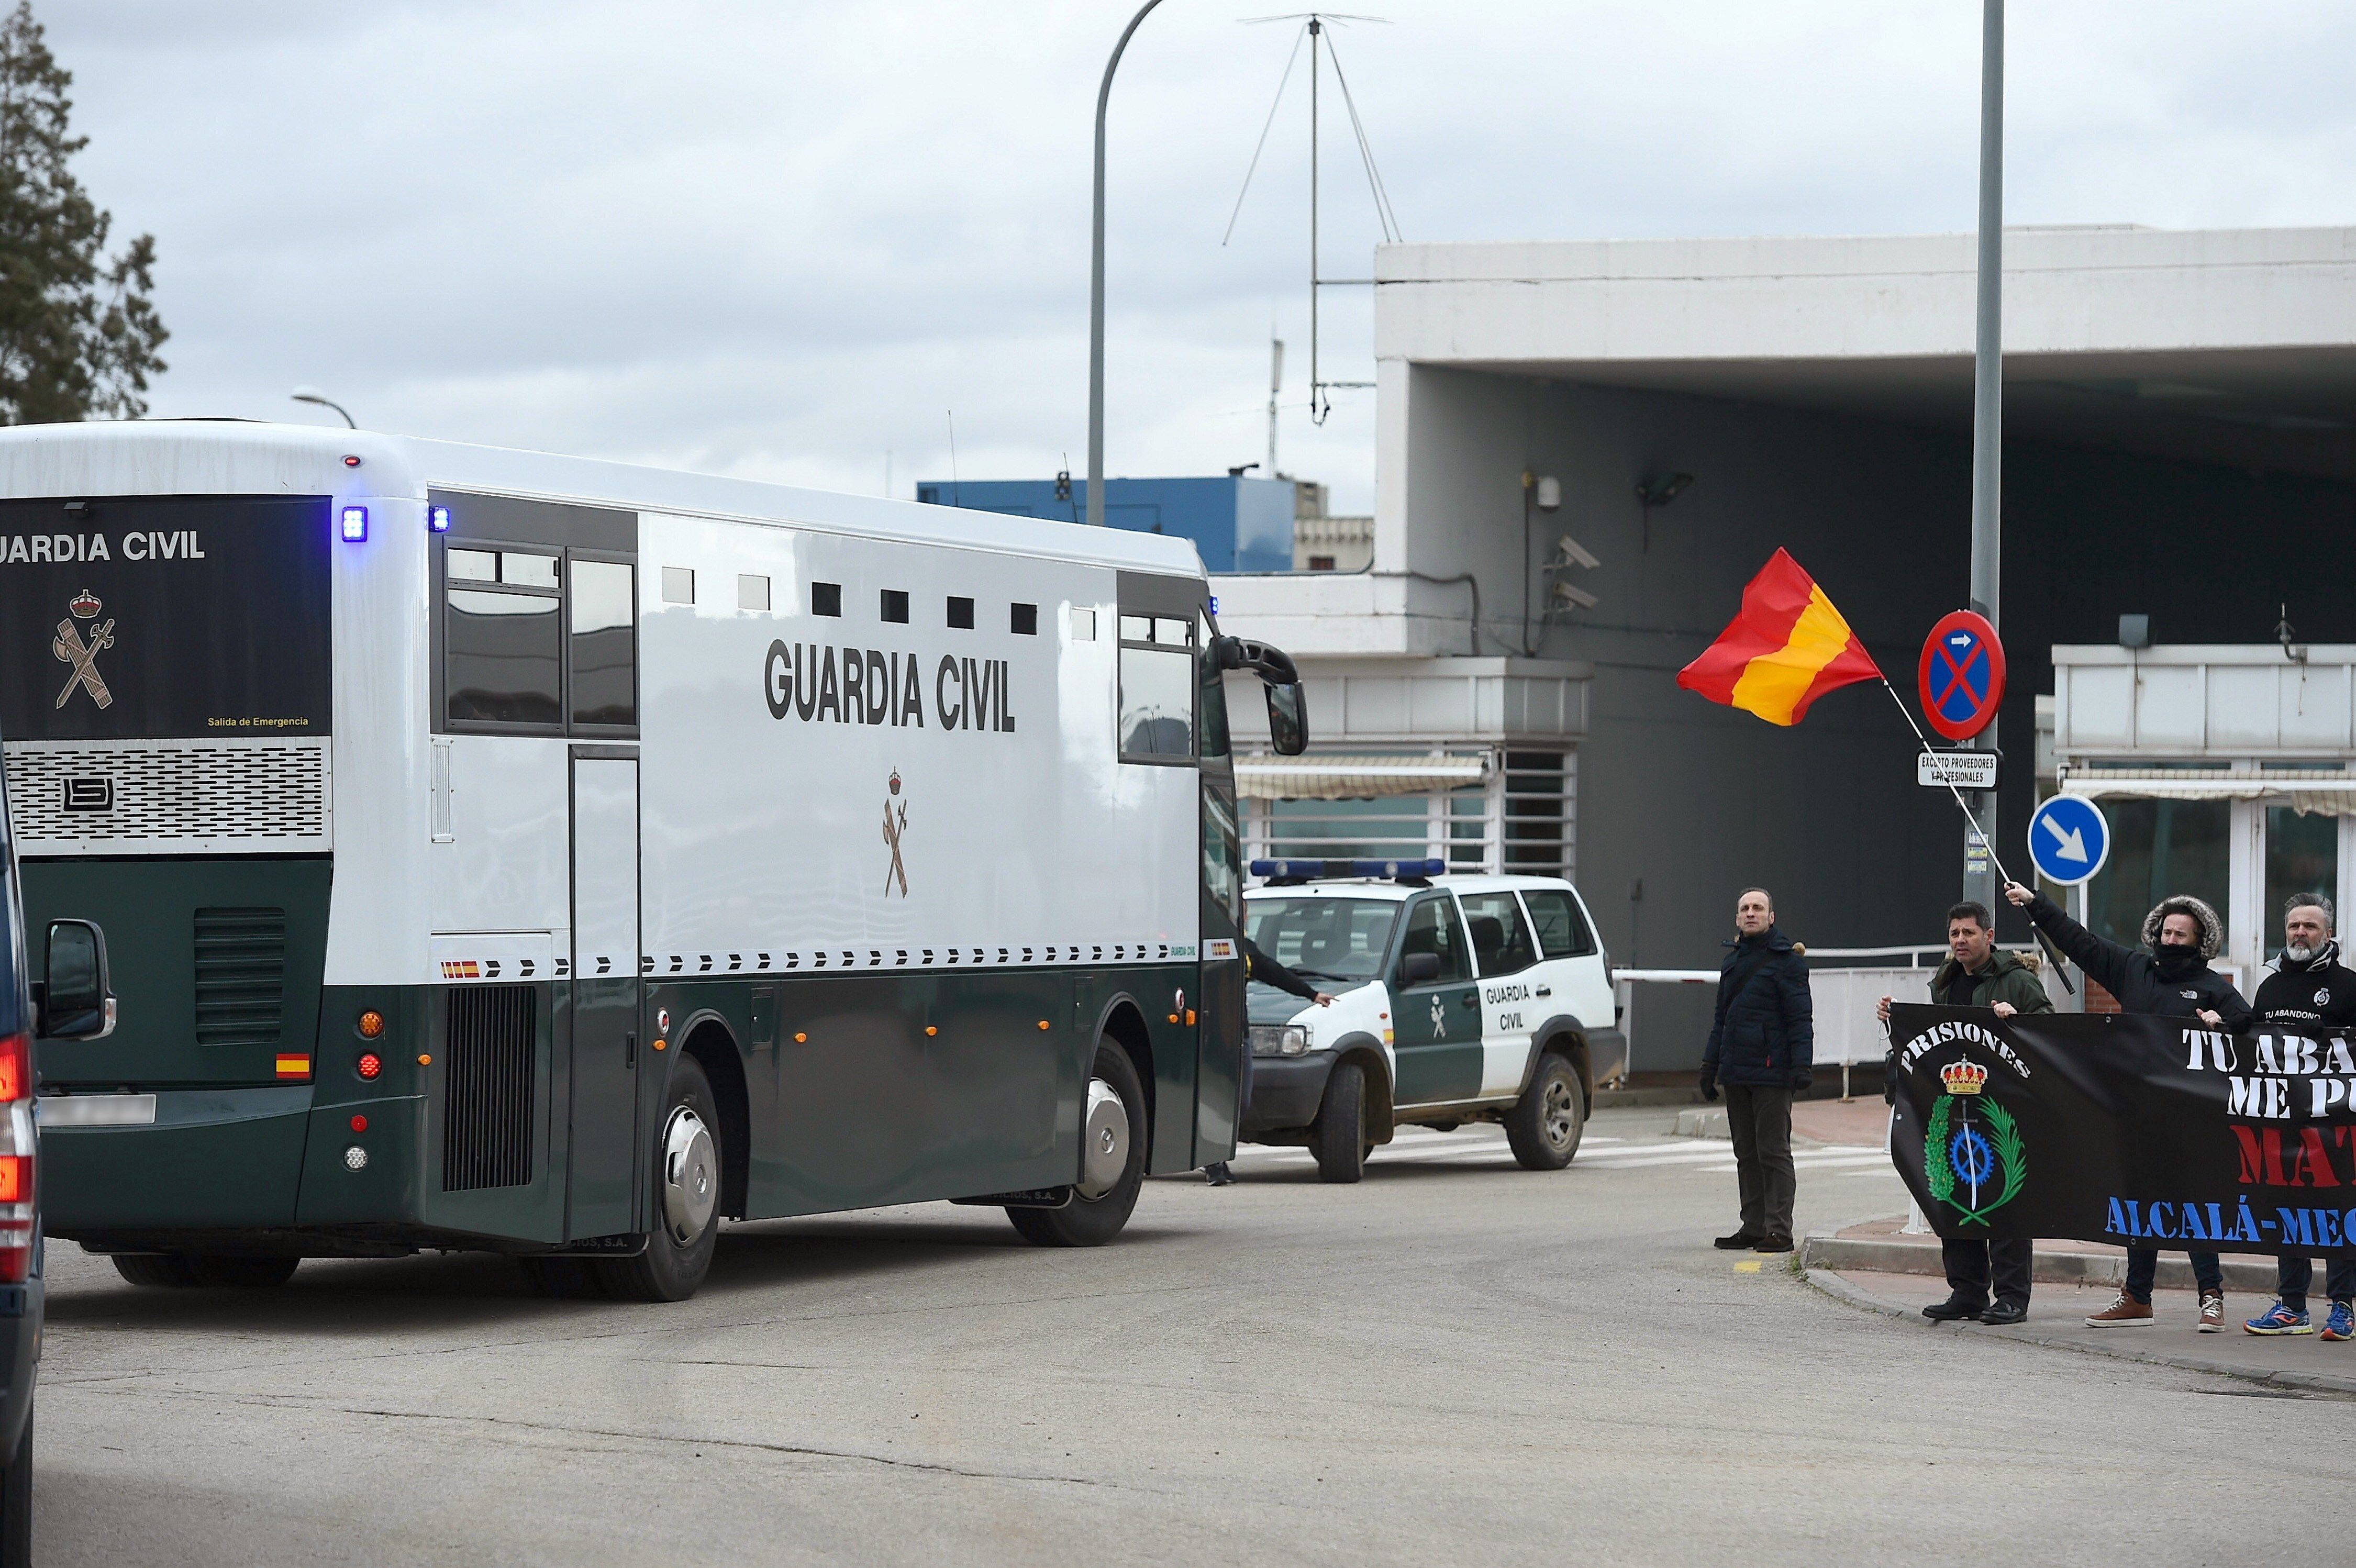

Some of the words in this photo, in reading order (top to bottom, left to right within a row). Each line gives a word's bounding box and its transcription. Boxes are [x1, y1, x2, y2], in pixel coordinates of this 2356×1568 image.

[123, 530, 205, 560] CIVIL
[764, 639, 924, 728] GUARDIA
[936, 654, 1015, 732] CIVIL
[208, 717, 236, 726] Salida
[239, 717, 251, 726] de
[253, 717, 308, 728] Emergencia
[1951, 758, 1994, 769] PROVEEDORES
[1486, 984, 1530, 1004] GUARDIA
[1500, 1013, 1524, 1030] CIVIL
[2265, 1011, 2274, 1019] TU
[1901, 1021, 2031, 1078] PRISIONES
[2182, 1029, 2237, 1072] TU
[2254, 1035, 2356, 1074] ABA
[2227, 1076, 2291, 1118] ME
[2309, 1078, 2356, 1118] P
[604, 1238, 628, 1247] S.A.
